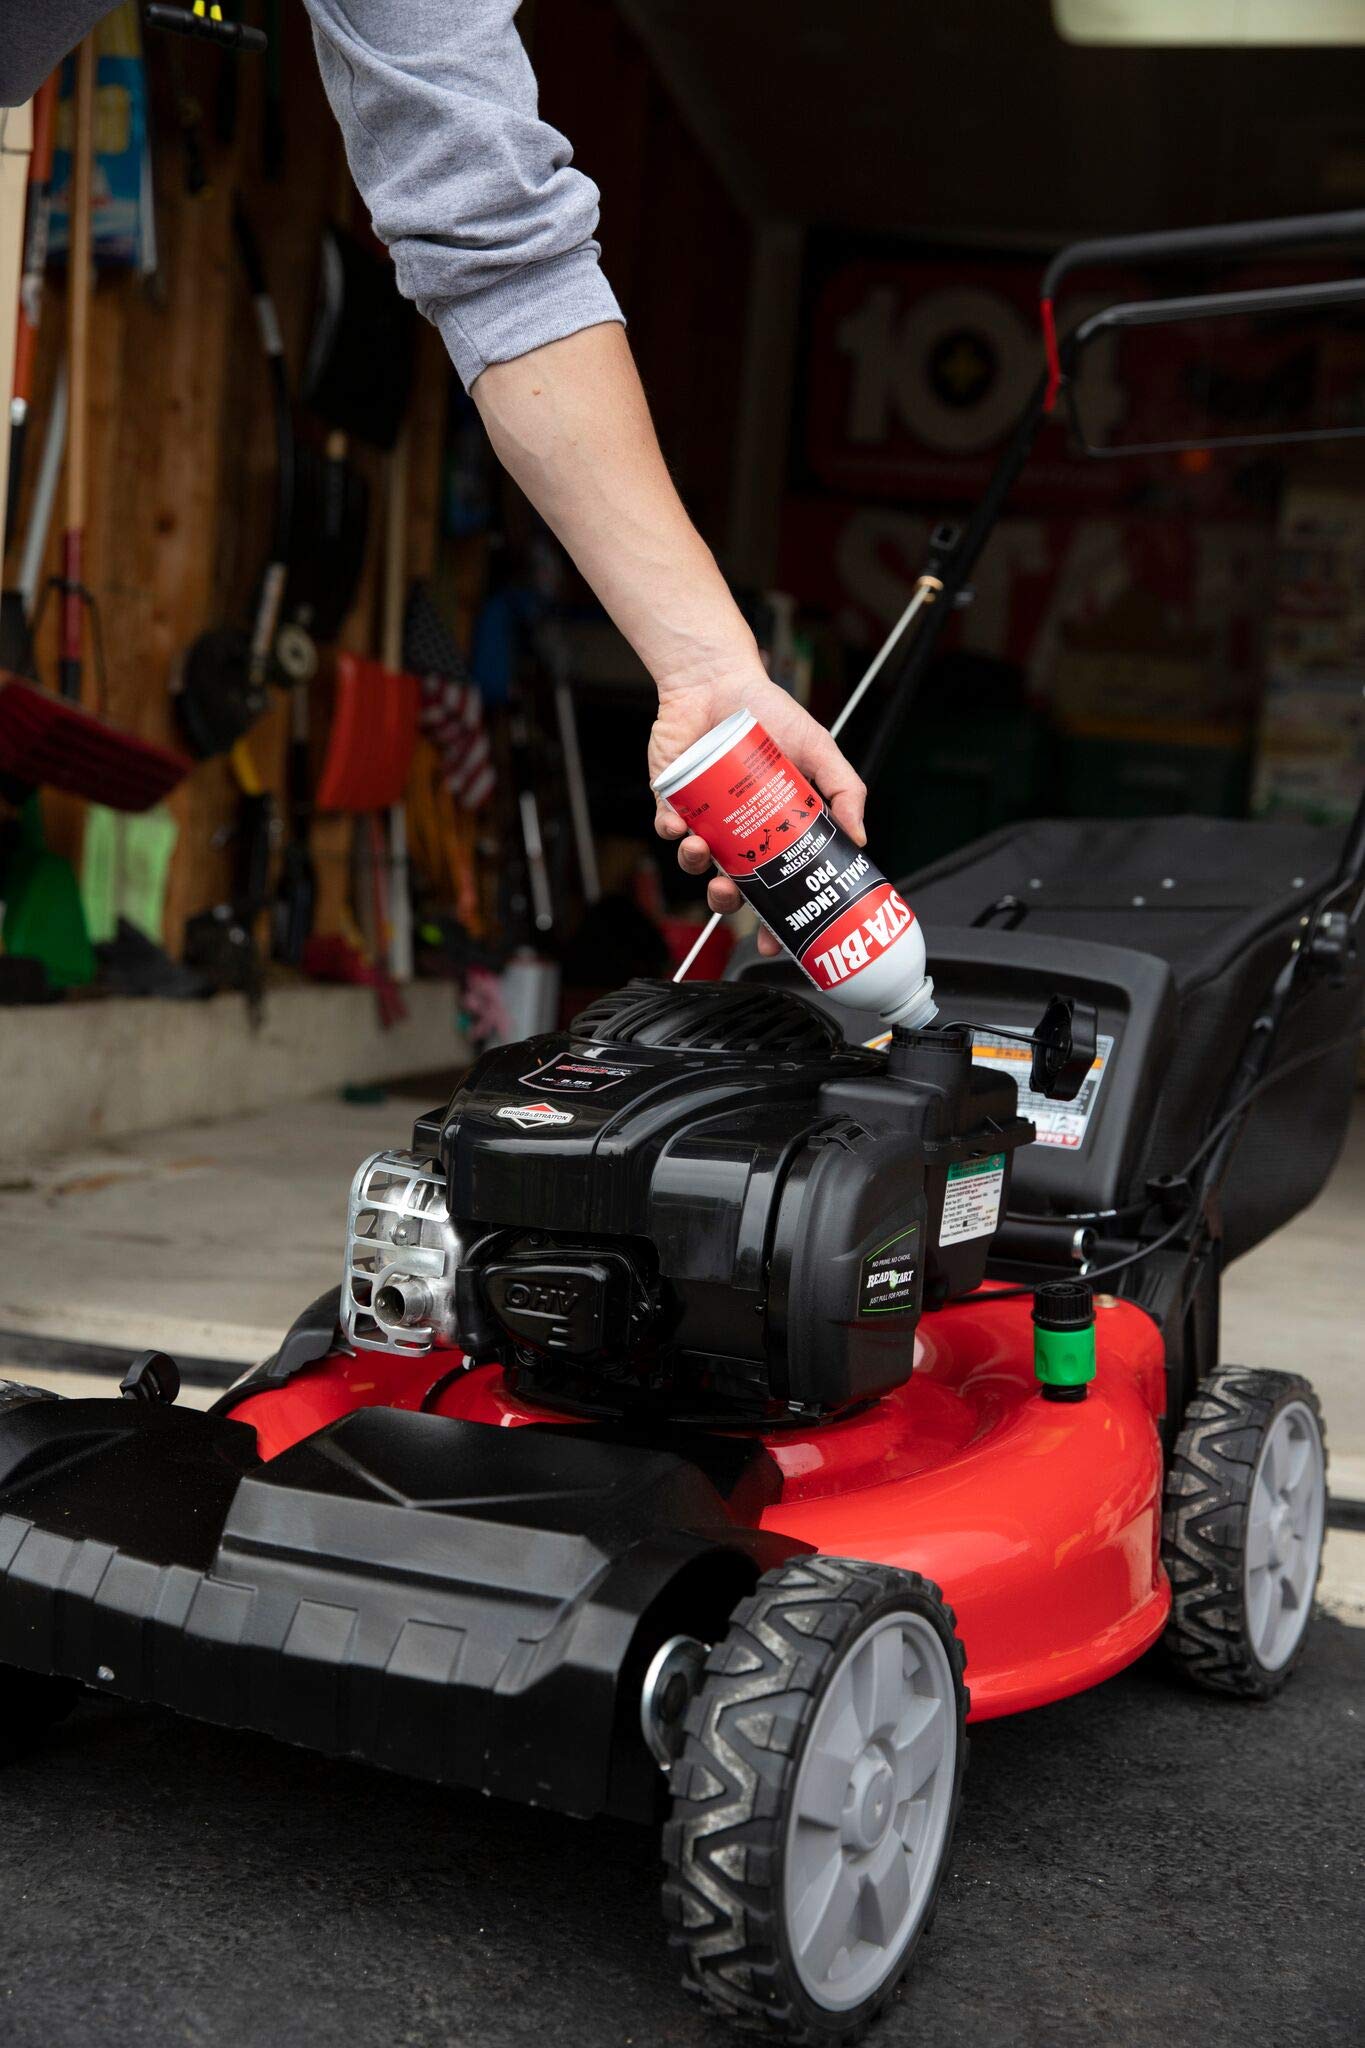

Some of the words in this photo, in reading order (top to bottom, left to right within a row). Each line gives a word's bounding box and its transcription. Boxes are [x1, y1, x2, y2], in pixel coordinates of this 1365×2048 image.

[765, 768, 786, 788] PROTECTS
[770, 777, 787, 795] QUIETS
[771, 778, 795, 803] LUBRICATES
[744, 786, 767, 807] AGAINST
[755, 791, 772, 807] NOISY
[781, 787, 798, 804] CLEANS
[722, 803, 746, 824] ETHANOL
[731, 800, 773, 836] VALVES/PISTONS
[733, 804, 757, 825] ENGINES
[779, 833, 827, 877] MULTI-SYSTEM
[782, 831, 815, 863] ADDITIVE
[805, 859, 839, 892] PRO
[835, 854, 870, 892] SMALL
[785, 885, 841, 932] ENGINE
[814, 890, 911, 984] STA-BIL
